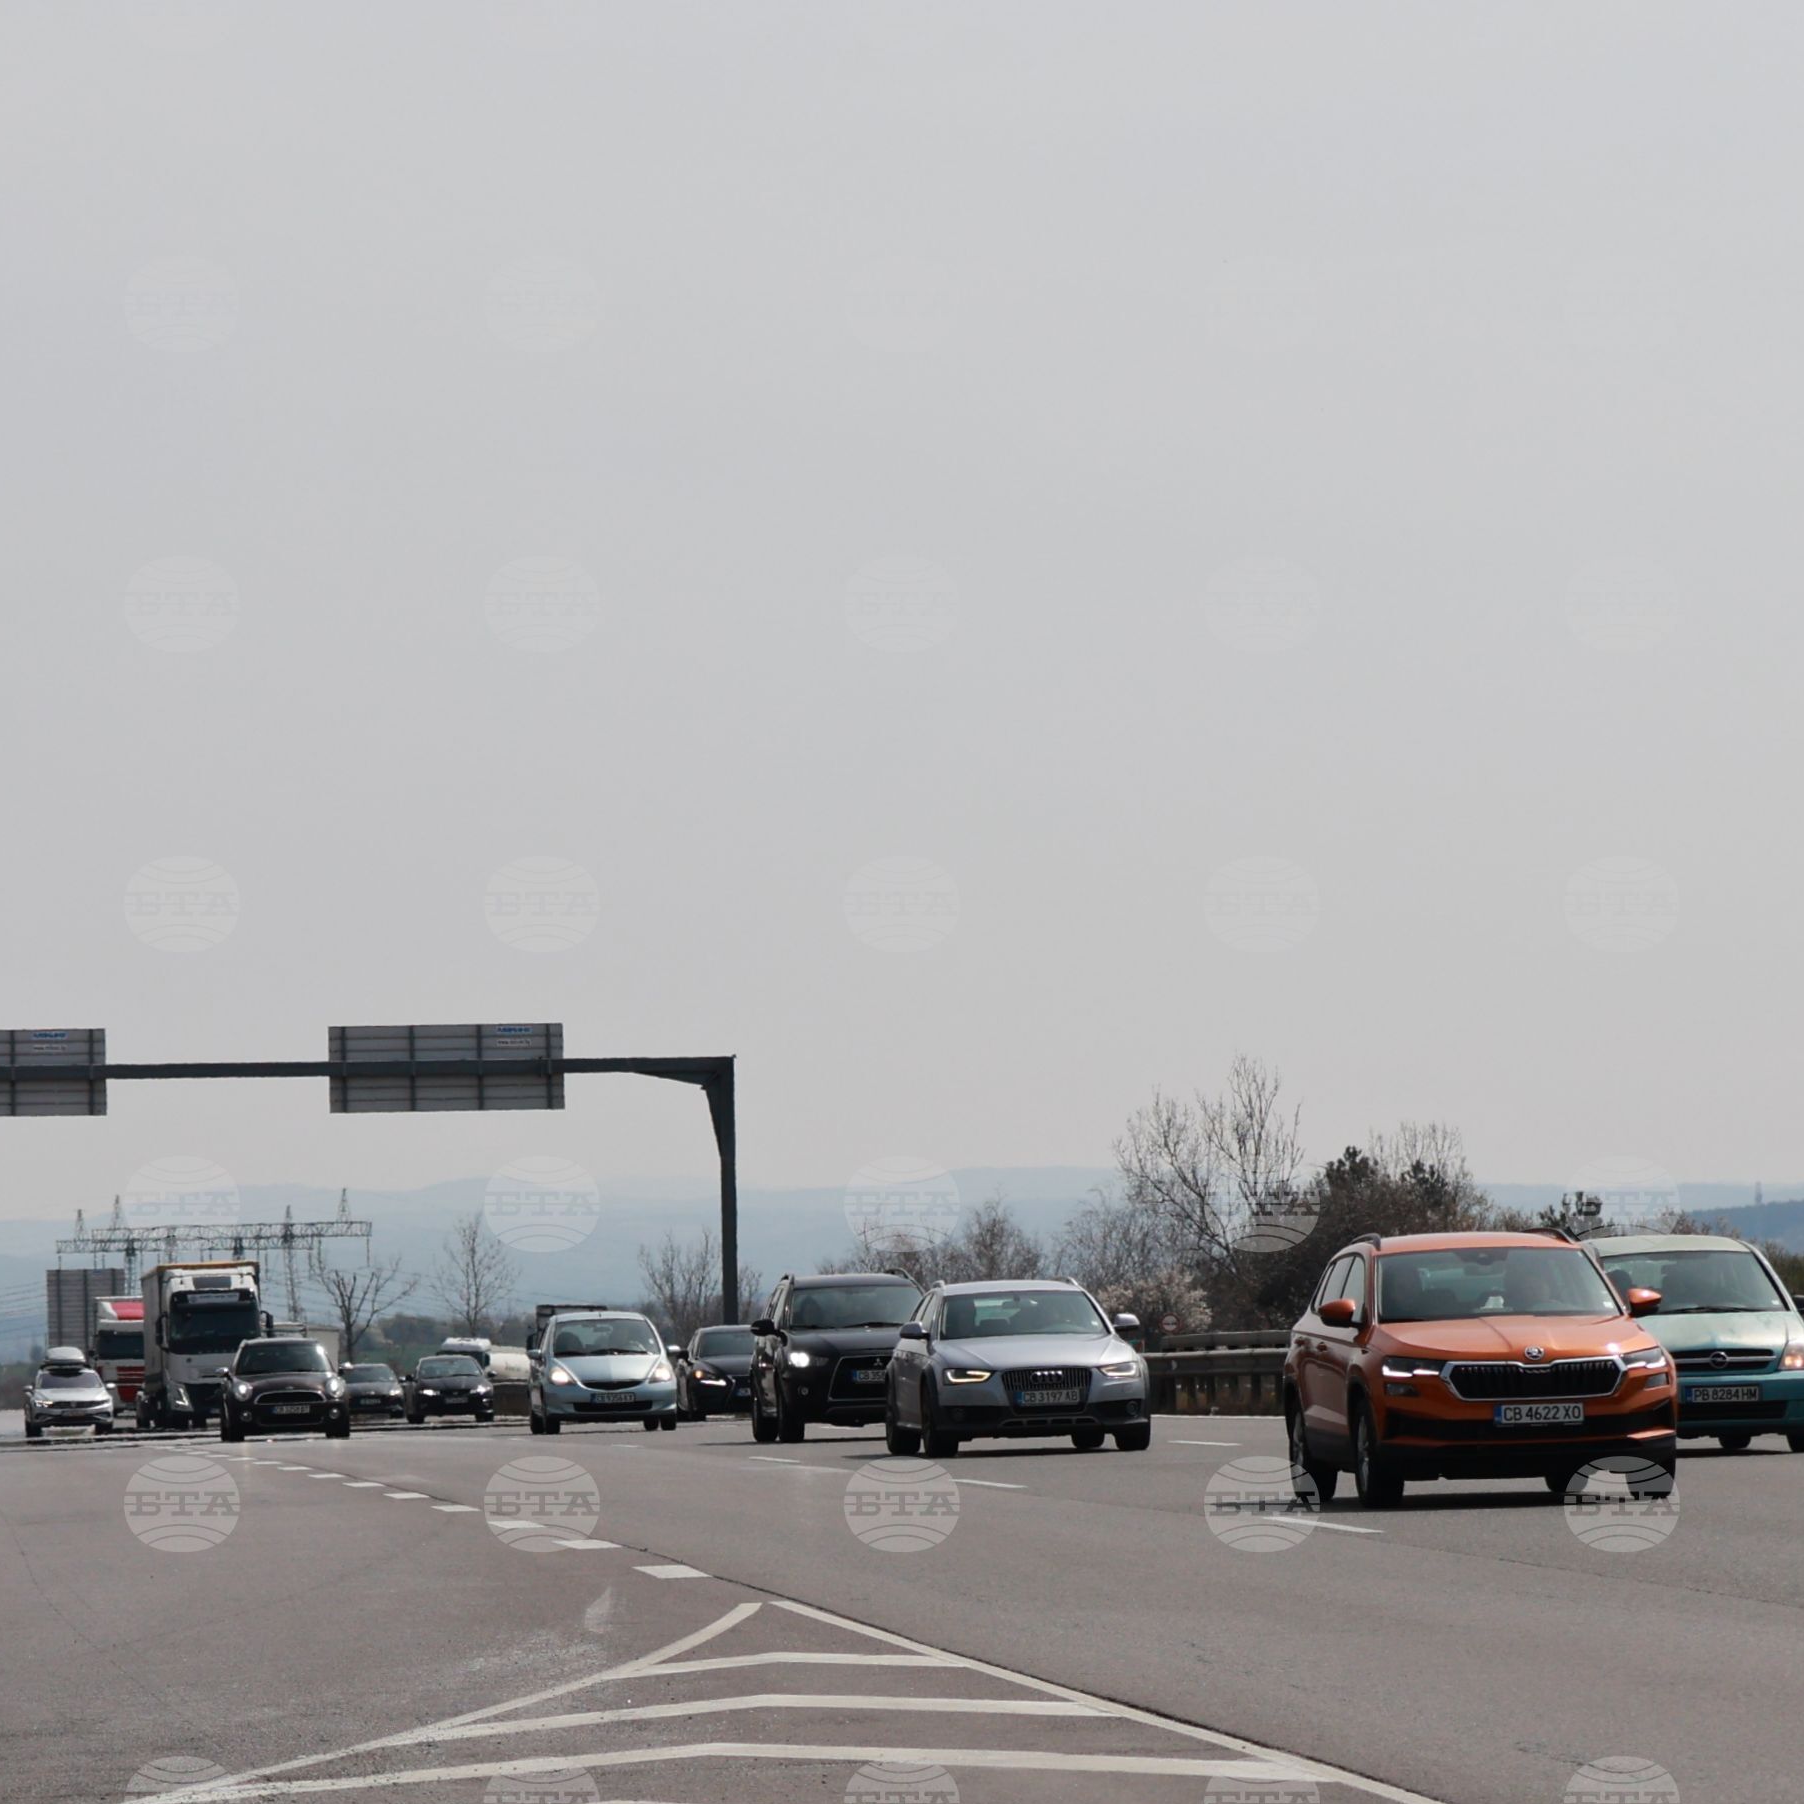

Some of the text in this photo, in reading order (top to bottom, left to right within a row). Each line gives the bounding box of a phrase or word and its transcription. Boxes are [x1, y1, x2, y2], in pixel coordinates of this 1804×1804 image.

[1024, 1390, 1078, 1402] CB 3197 AB
[1693, 1388, 1757, 1401] PB 8284 HM
[1503, 1405, 1581, 1421] CB 4622 XO
